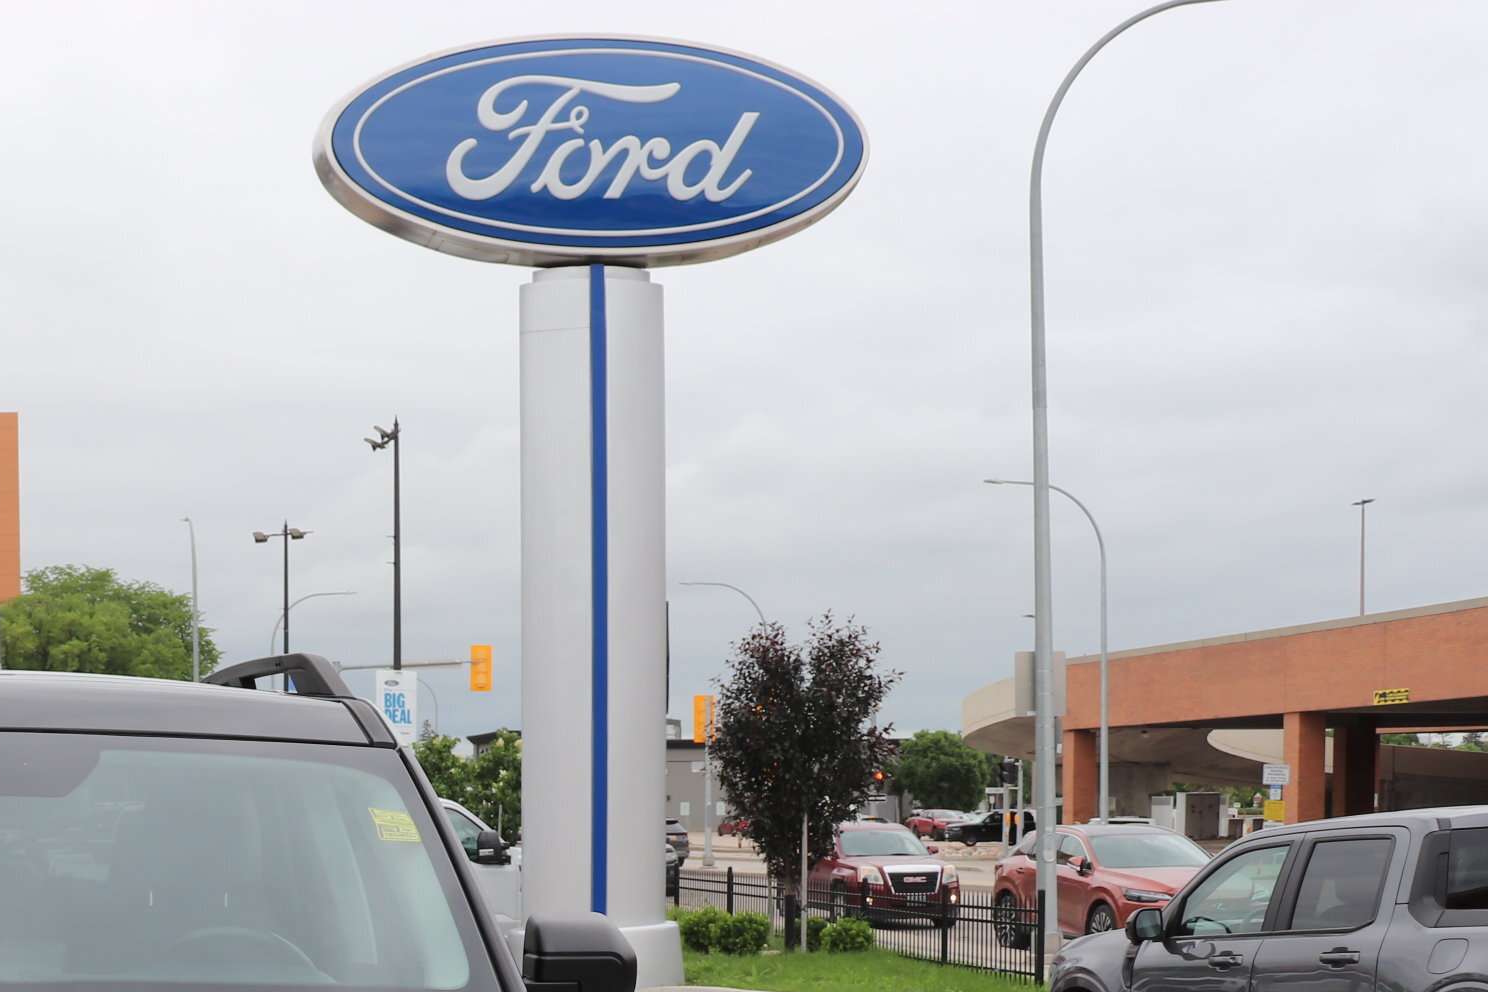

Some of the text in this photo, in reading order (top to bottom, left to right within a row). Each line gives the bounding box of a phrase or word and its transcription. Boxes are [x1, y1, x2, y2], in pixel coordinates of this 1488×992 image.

[446, 74, 760, 202] Ford
[384, 692, 405, 709] BIG
[384, 708, 412, 724] DEAL
